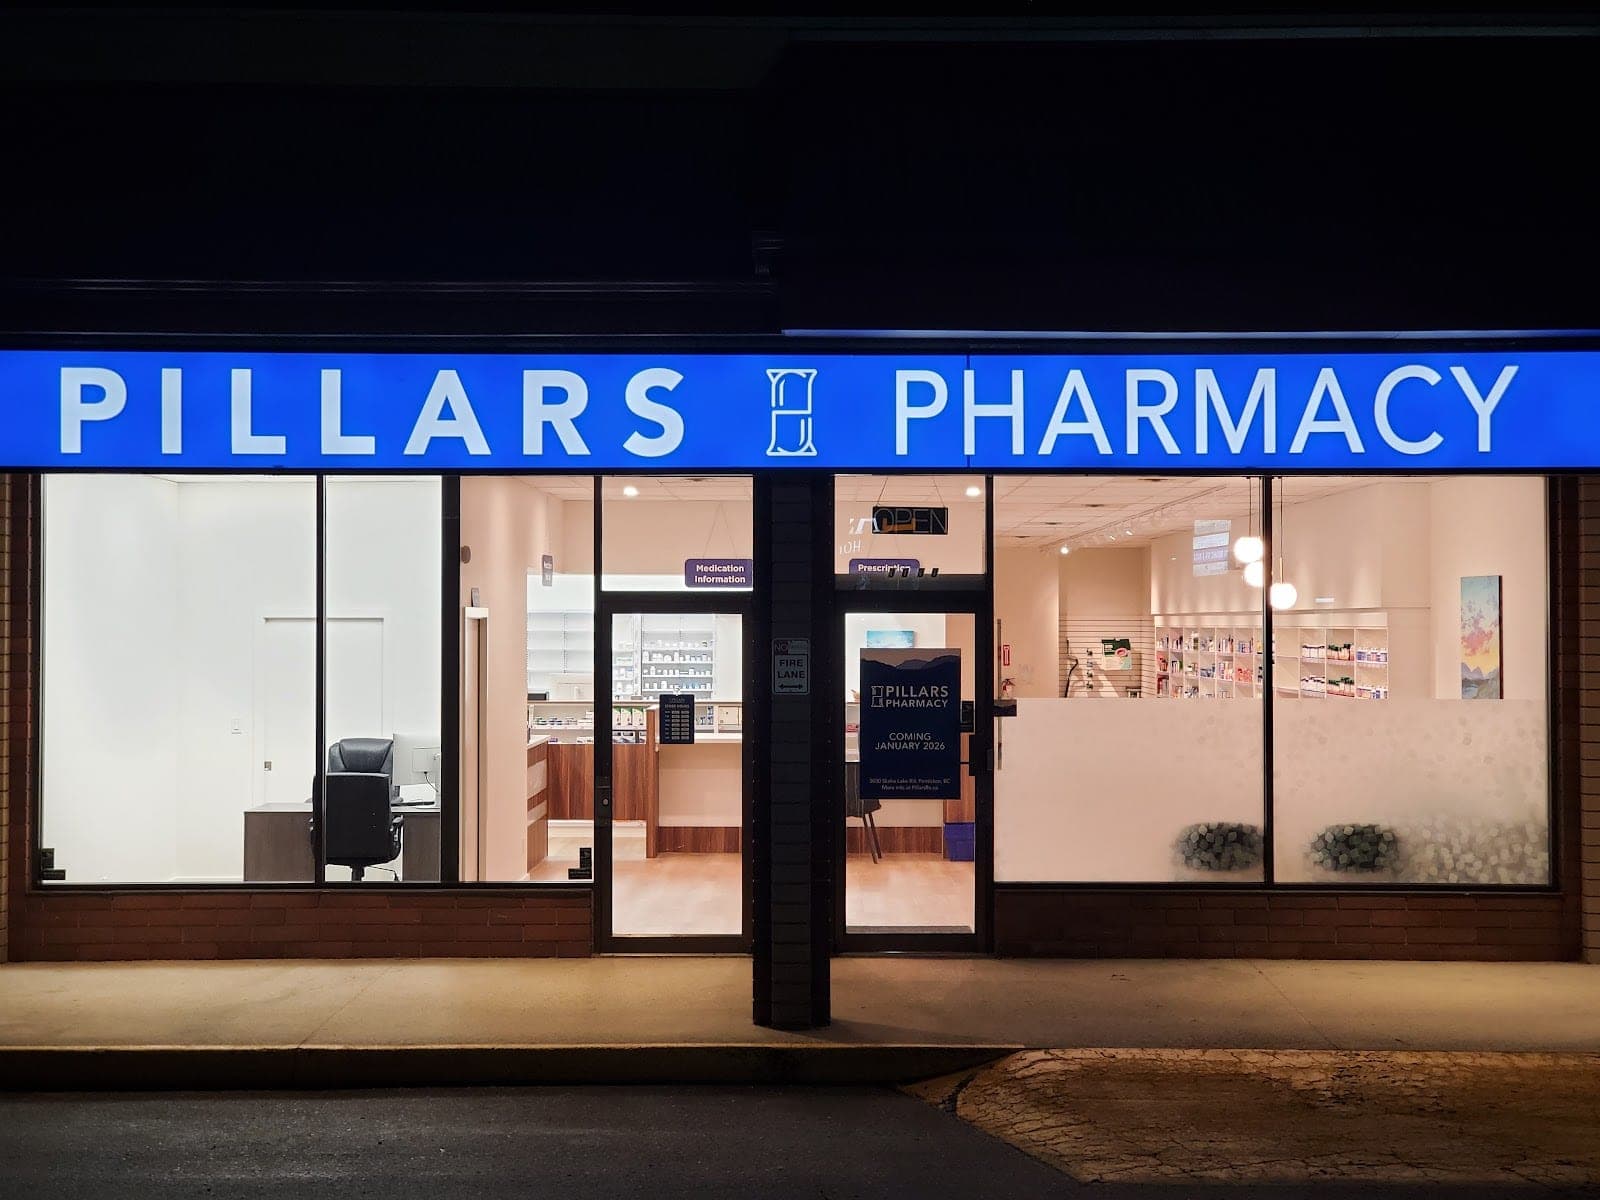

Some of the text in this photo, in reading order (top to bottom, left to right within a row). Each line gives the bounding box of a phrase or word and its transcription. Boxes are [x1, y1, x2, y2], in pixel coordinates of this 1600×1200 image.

[60, 364, 1518, 457] PILLARS PHARMACY
[874, 508, 947, 534] OPEN
[696, 564, 745, 572] Medication
[694, 575, 746, 583] Information
[779, 659, 804, 667] FIRE
[777, 671, 806, 679] LANE
[885, 685, 949, 698] PILLARS
[885, 699, 948, 708] PHARMACY
[889, 732, 931, 741] COMING
[875, 742, 946, 750] JANUARY 2026
